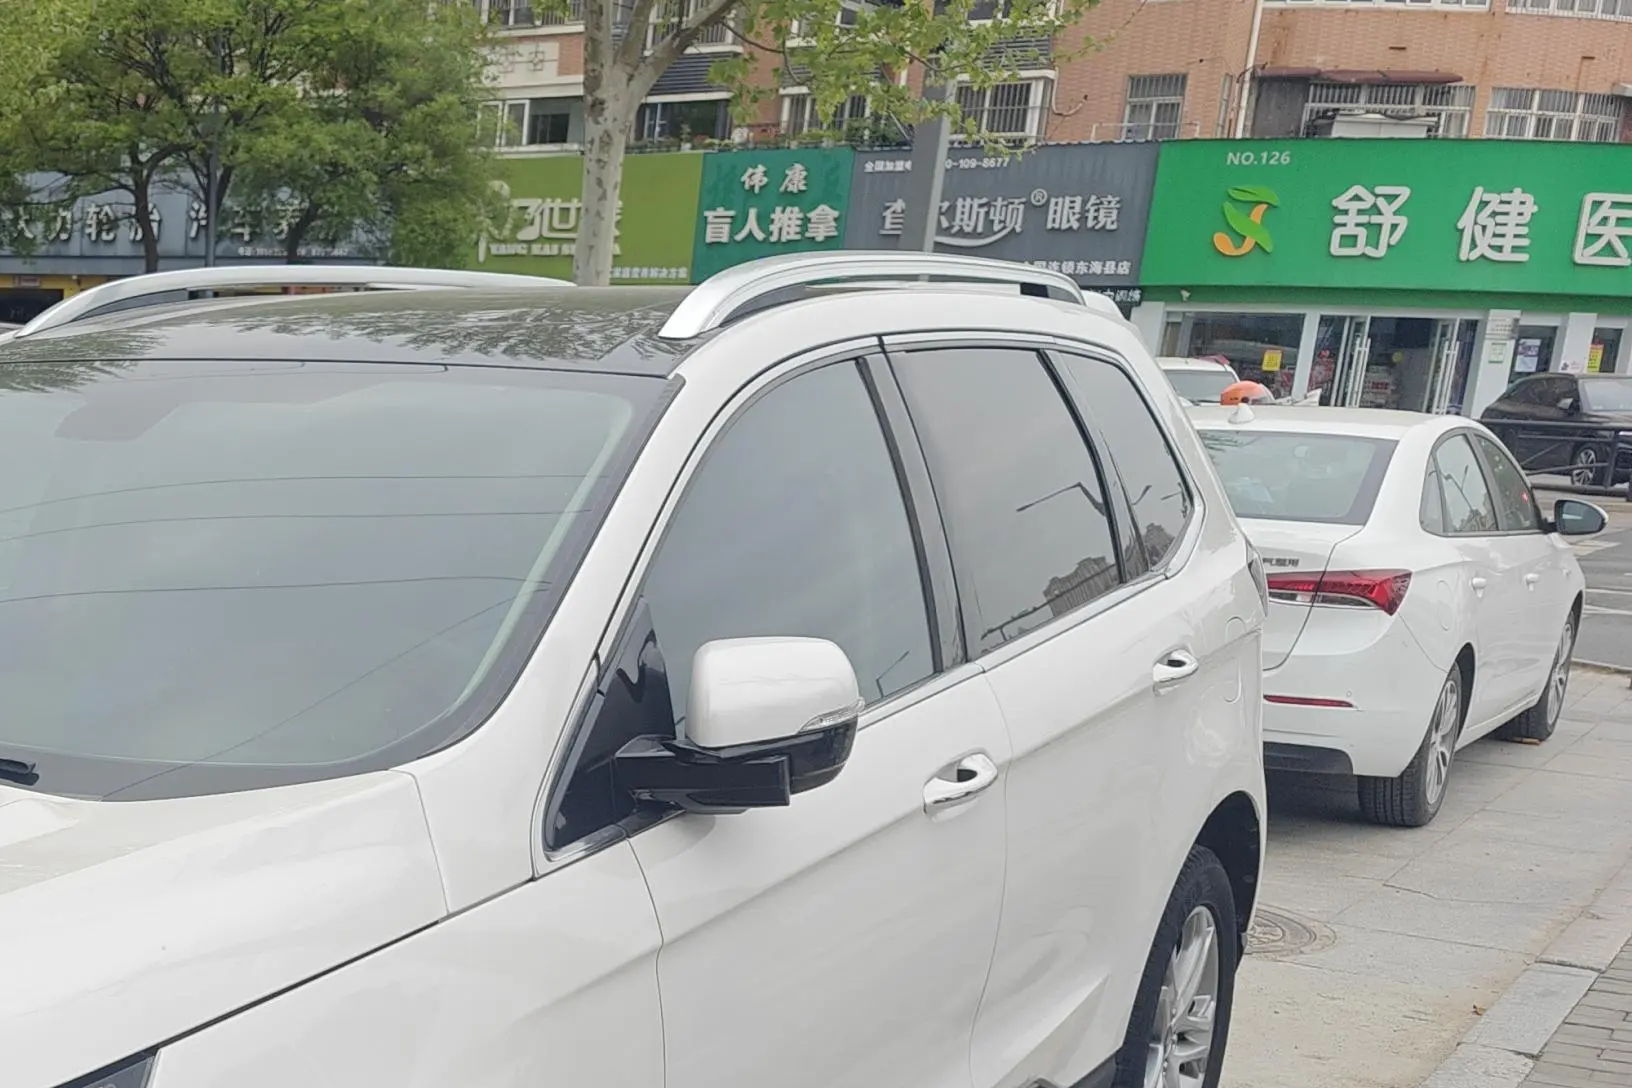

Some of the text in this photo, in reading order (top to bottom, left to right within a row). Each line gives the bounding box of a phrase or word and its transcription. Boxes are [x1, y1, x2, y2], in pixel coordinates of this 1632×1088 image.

[1226, 151, 1291, 166] NO.126
[741, 163, 809, 194] 伟康
[703, 204, 840, 243] 盲人推拿
[1330, 185, 1632, 266] 舒健医
